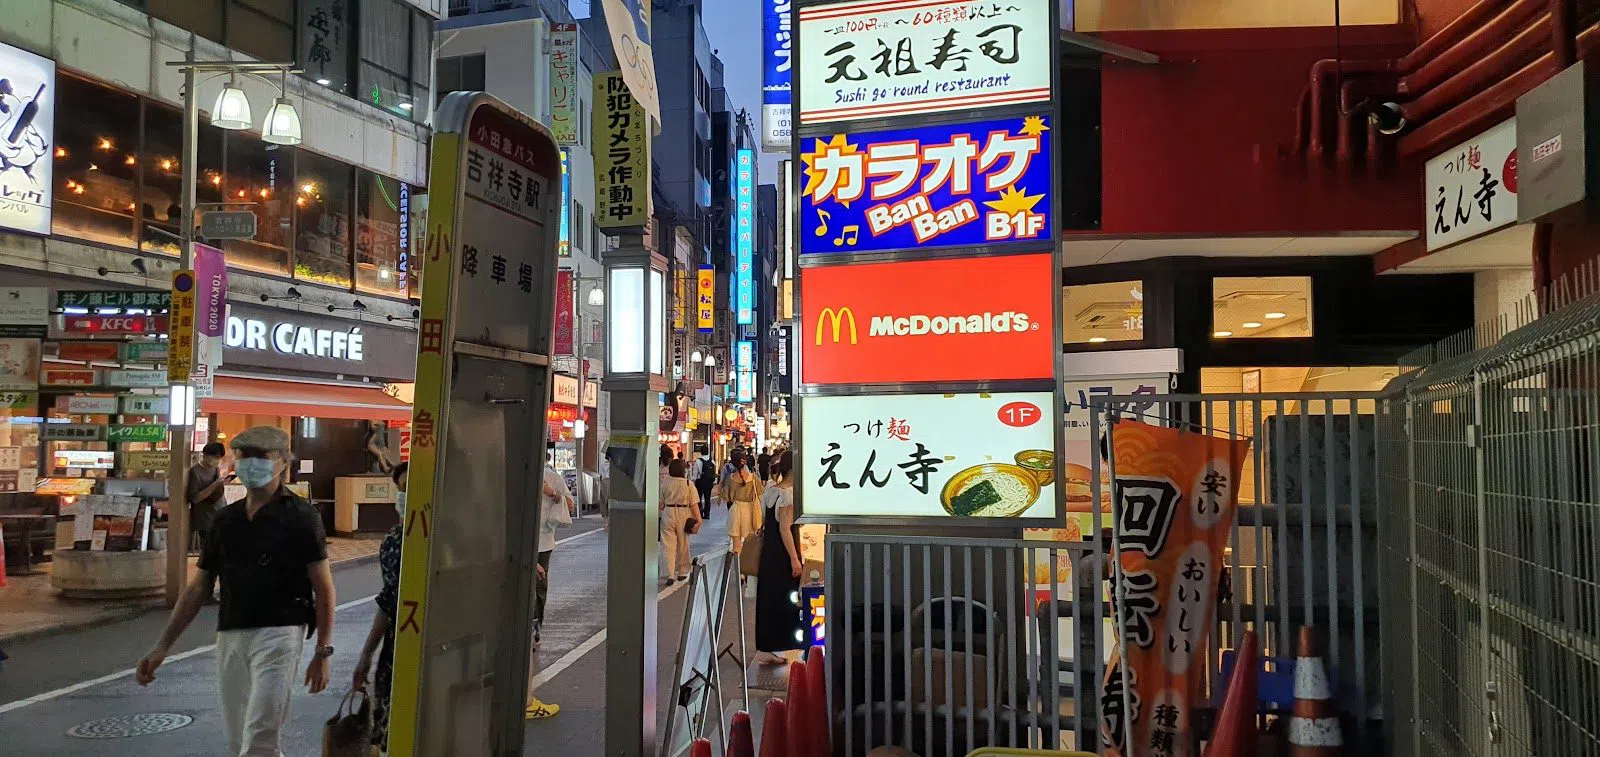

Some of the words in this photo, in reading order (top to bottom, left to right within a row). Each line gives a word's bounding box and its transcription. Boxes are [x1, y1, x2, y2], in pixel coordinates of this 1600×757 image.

[824, 24, 1023, 84] 元祖寿司
[552, 50, 569, 121] きゃりこ
[835, 89, 866, 104] Sushi
[935, 73, 1011, 91] restaurant
[477, 126, 536, 166] 小田急バス
[607, 76, 633, 221] 防犯カメラ作動中
[634, 100, 642, 178] 心まちづくり
[1444, 144, 1481, 174] つけ麺
[467, 149, 540, 210] 吉祥寺駅
[813, 131, 1039, 204] カラオケ
[865, 194, 931, 237] Ban
[911, 199, 979, 244] Ban
[986, 210, 1045, 240] B1F
[1434, 167, 1499, 234] えん寺
[461, 244, 533, 293] 降車場
[100, 318, 134, 330] KFC
[700, 294, 712, 319] 松屋
[869, 311, 1030, 337] McDonald's
[273, 323, 363, 360] CAFFÉ
[399, 223, 450, 634] 小田急バス
[843, 416, 911, 442] つけ麺
[1005, 407, 1035, 423] 1F
[818, 442, 944, 495] えん寺
[1197, 470, 1227, 515] 安い
[1167, 557, 1206, 653] おいしい
